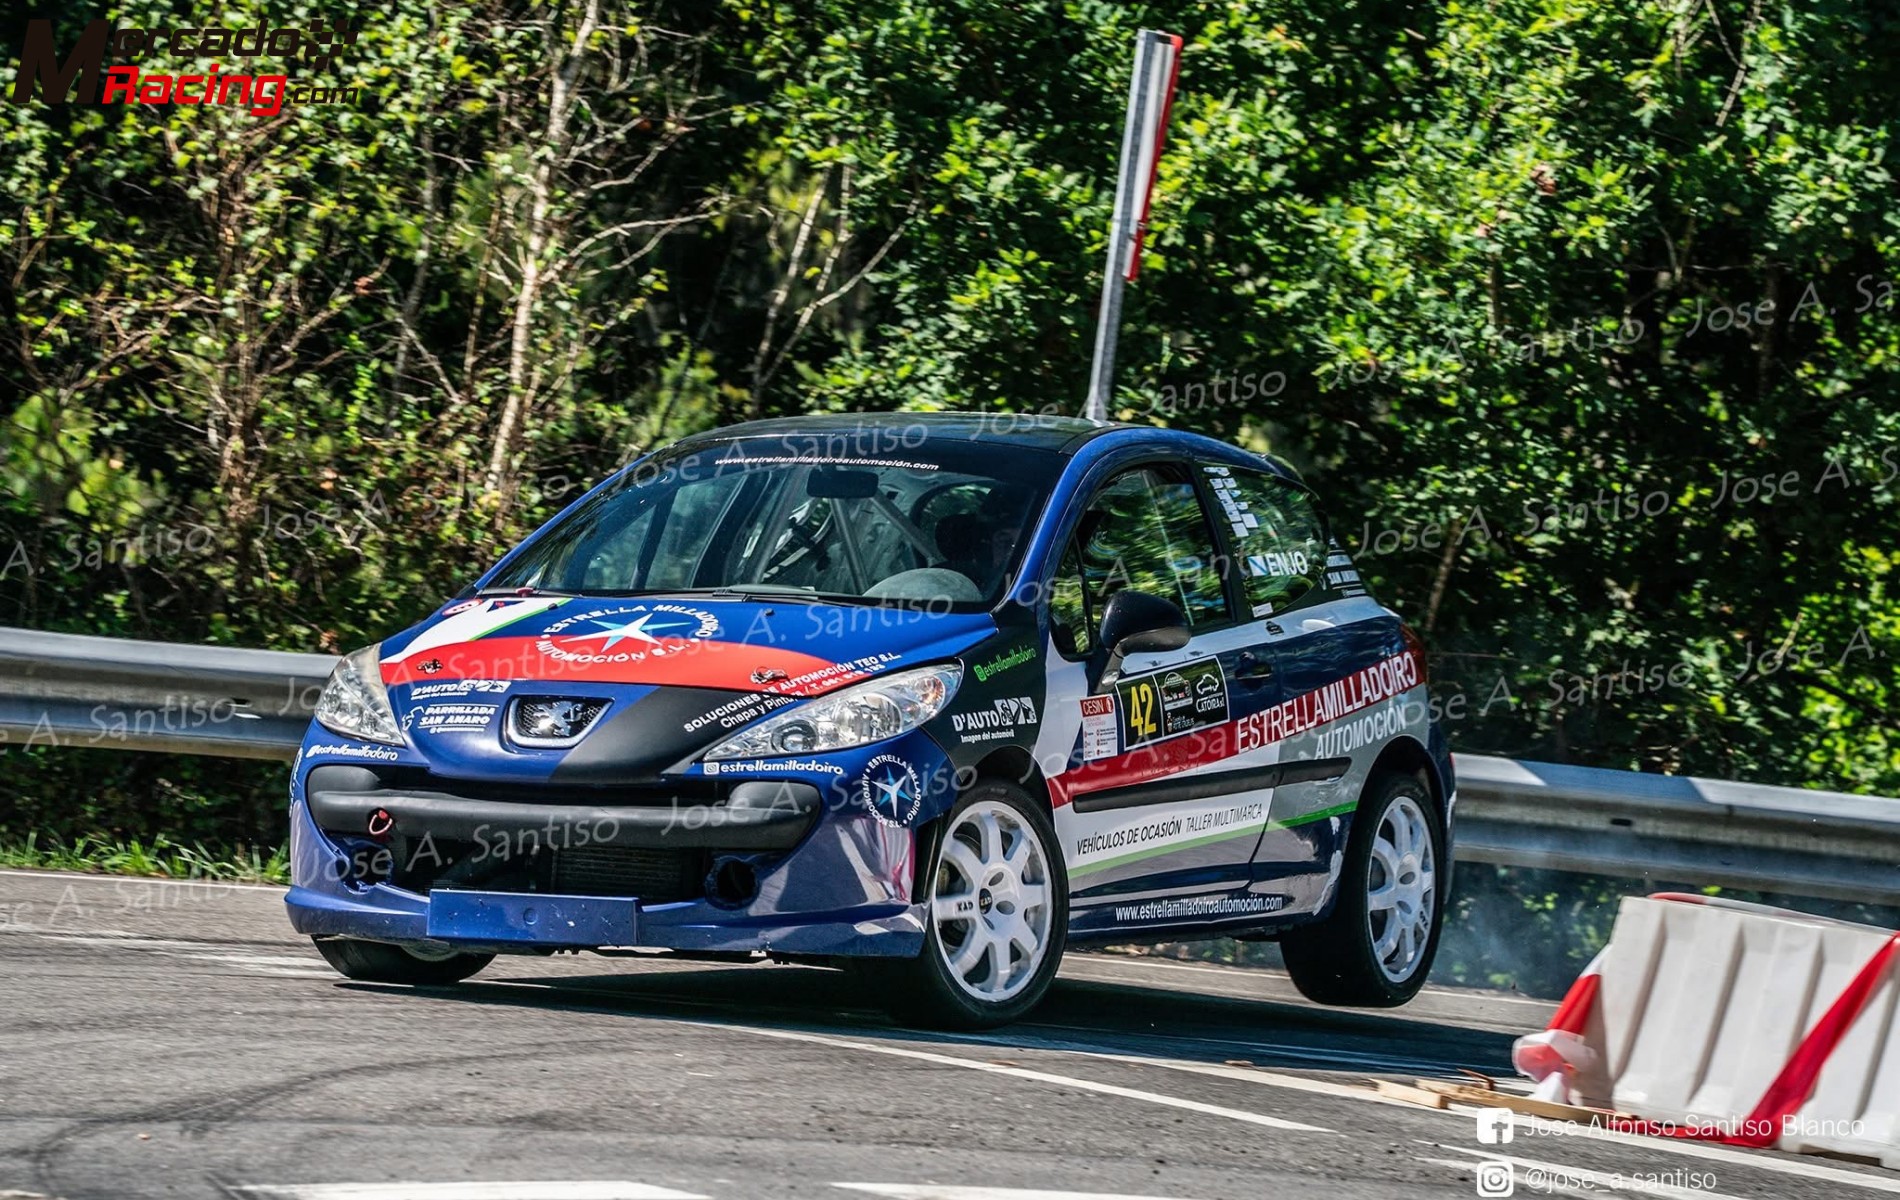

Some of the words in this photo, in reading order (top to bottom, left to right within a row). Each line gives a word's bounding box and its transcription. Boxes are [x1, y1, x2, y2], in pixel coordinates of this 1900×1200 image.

[545, 605, 647, 633] ESTRELLA
[535, 640, 646, 663] AUTOMOCIÓN
[683, 693, 761, 732] SOLUCIONES
[779, 661, 855, 690] AUTOMOCIÓN
[855, 656, 879, 668] TEO
[1238, 652, 1418, 753] ESTRELLAMILLADOIRO
[420, 716, 444, 726] SAN
[445, 715, 491, 725] AMARO
[425, 706, 495, 715] PARRILLADA
[720, 709, 757, 728] Chapa
[952, 710, 999, 731] D'AUTO
[1131, 683, 1156, 736] 42
[961, 734, 981, 743] Imagen
[982, 731, 990, 740] del
[1314, 703, 1406, 760] AUTOMOCIÓN
[720, 760, 844, 776] estrellamilladoiro
[867, 754, 907, 769] ESTRELLA
[907, 766, 921, 821] MILLADOIRO
[1077, 828, 1125, 856] VEHÍCULOS
[1126, 828, 1140, 846] DE
[1140, 818, 1183, 842] OCASIÓN
[1186, 814, 1213, 833] TALLER
[1213, 804, 1263, 829] MULTIMARCA
[1115, 895, 1283, 921] www.estrellamilladoiroautomoción.com
